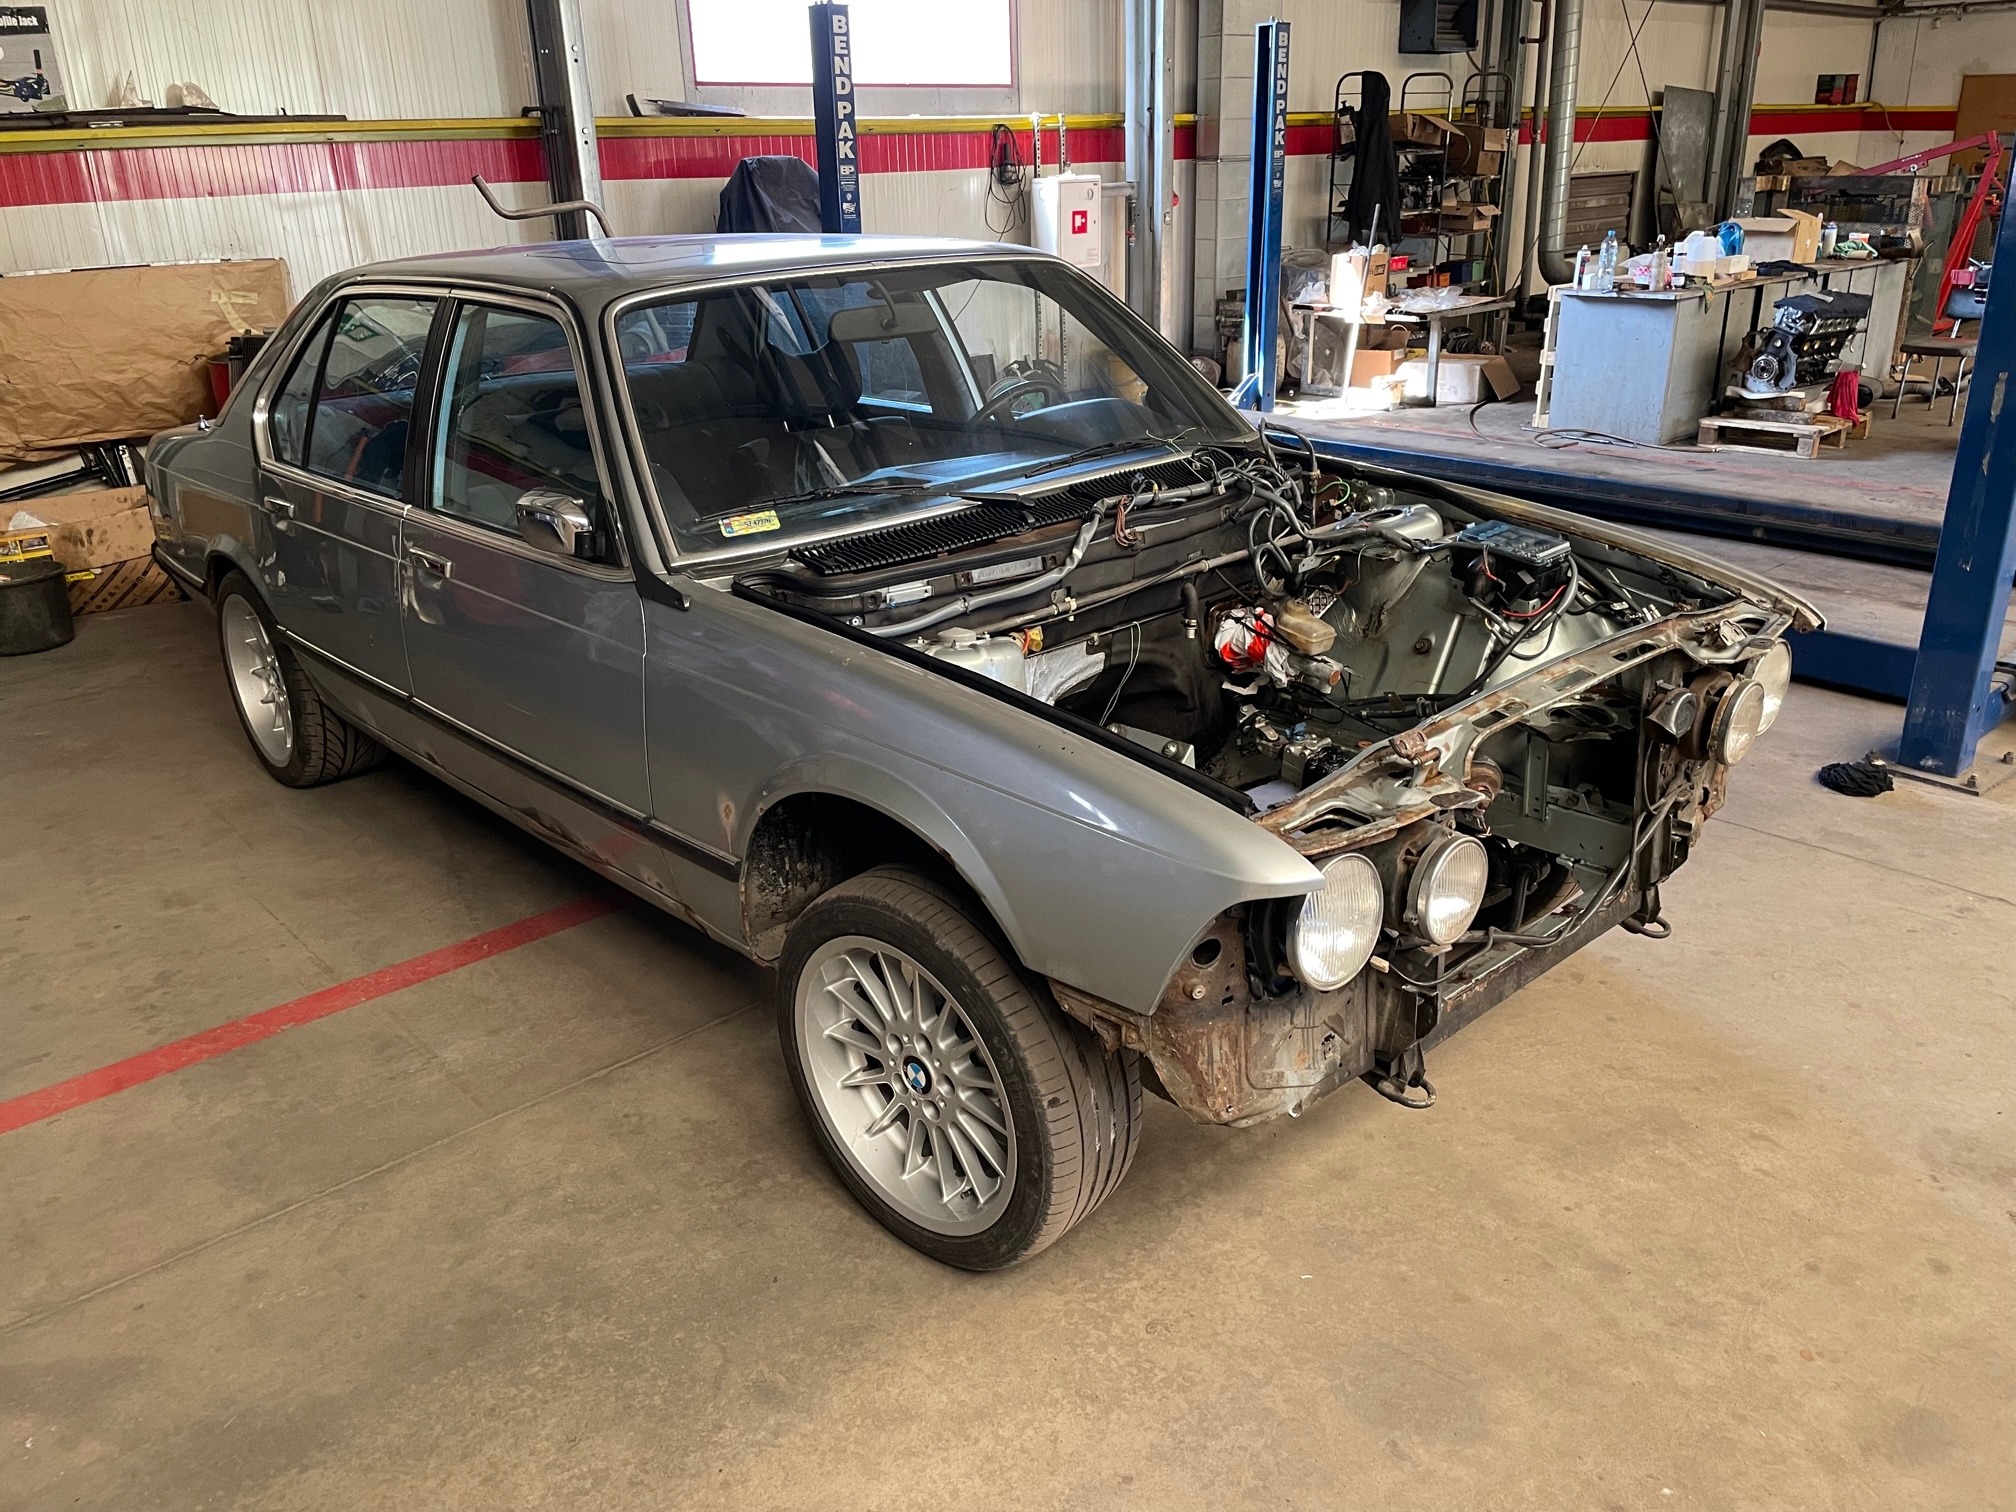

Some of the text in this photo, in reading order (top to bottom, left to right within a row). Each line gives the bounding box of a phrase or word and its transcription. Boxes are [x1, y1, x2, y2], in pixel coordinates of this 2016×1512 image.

[832, 14, 851, 95] BEND
[1274, 32, 1289, 146] BEND PAK
[837, 101, 855, 159] PAK
[840, 164, 855, 175] BP
